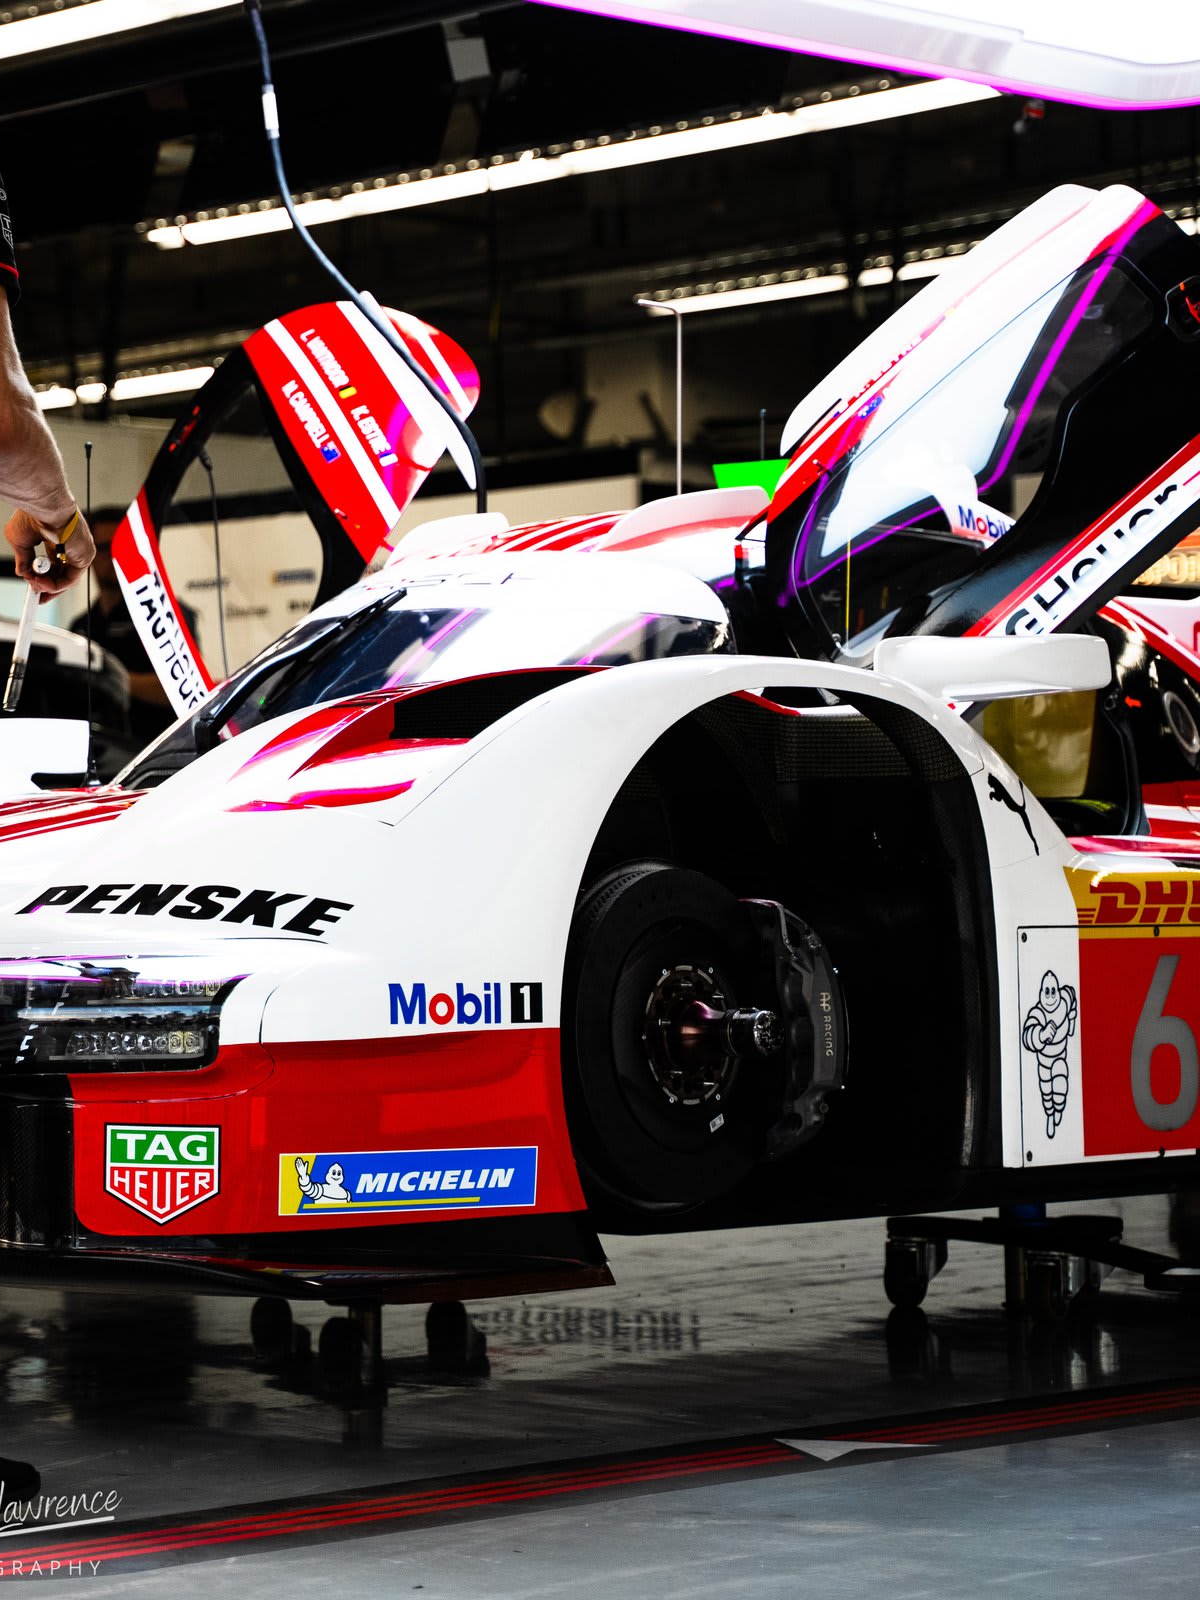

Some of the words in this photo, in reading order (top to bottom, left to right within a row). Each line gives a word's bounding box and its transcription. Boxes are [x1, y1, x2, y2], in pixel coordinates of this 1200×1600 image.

[14, 884, 355, 937] PENSKE
[388, 982, 501, 1025] Mobil
[823, 1015, 834, 1057] RACING
[1131, 954, 1199, 1131] 6
[116, 1132, 208, 1162] TAG
[113, 1169, 211, 1215] HEUER
[355, 1167, 515, 1194] MICHELIN
